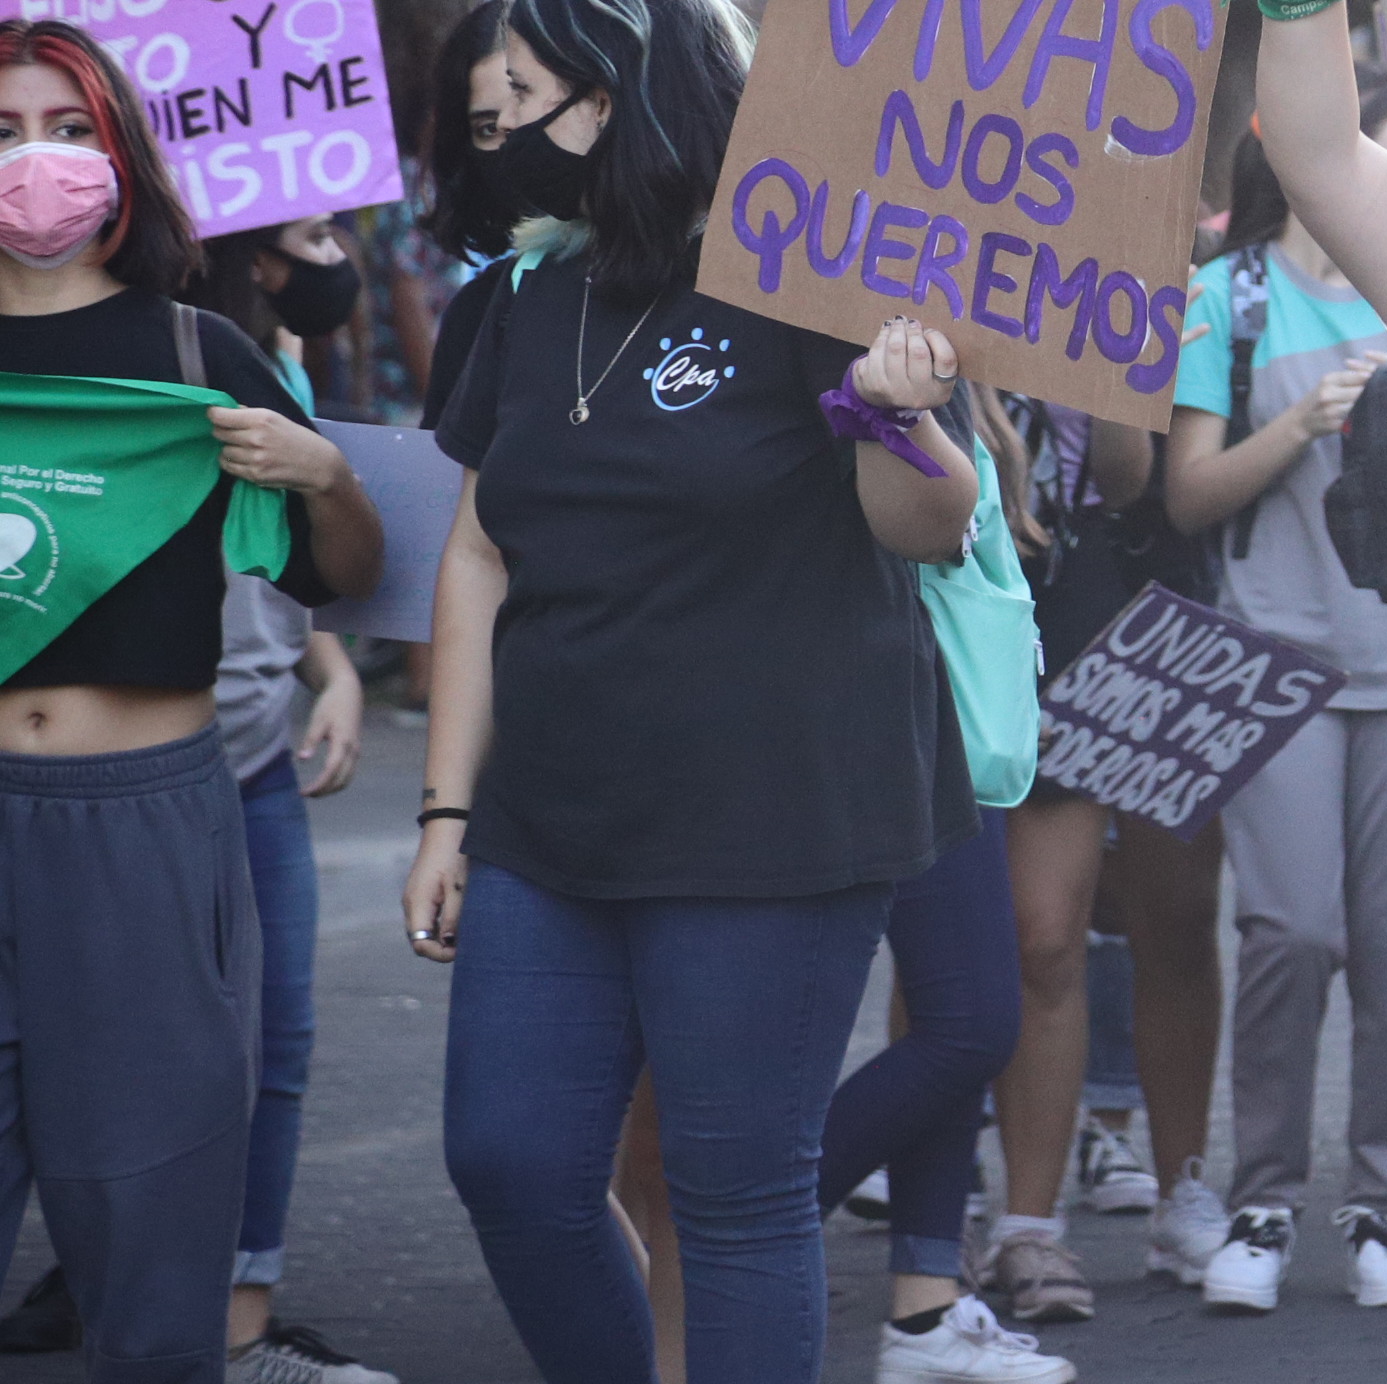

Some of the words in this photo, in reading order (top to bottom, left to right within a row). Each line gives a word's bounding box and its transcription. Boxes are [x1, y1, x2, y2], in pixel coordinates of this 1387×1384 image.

[232, 1, 277, 69] Y
[283, 56, 374, 118] ME
[873, 88, 1080, 227] NOS
[731, 157, 1187, 395] QUEREMOS
[1050, 652, 1182, 742] SOMOS
